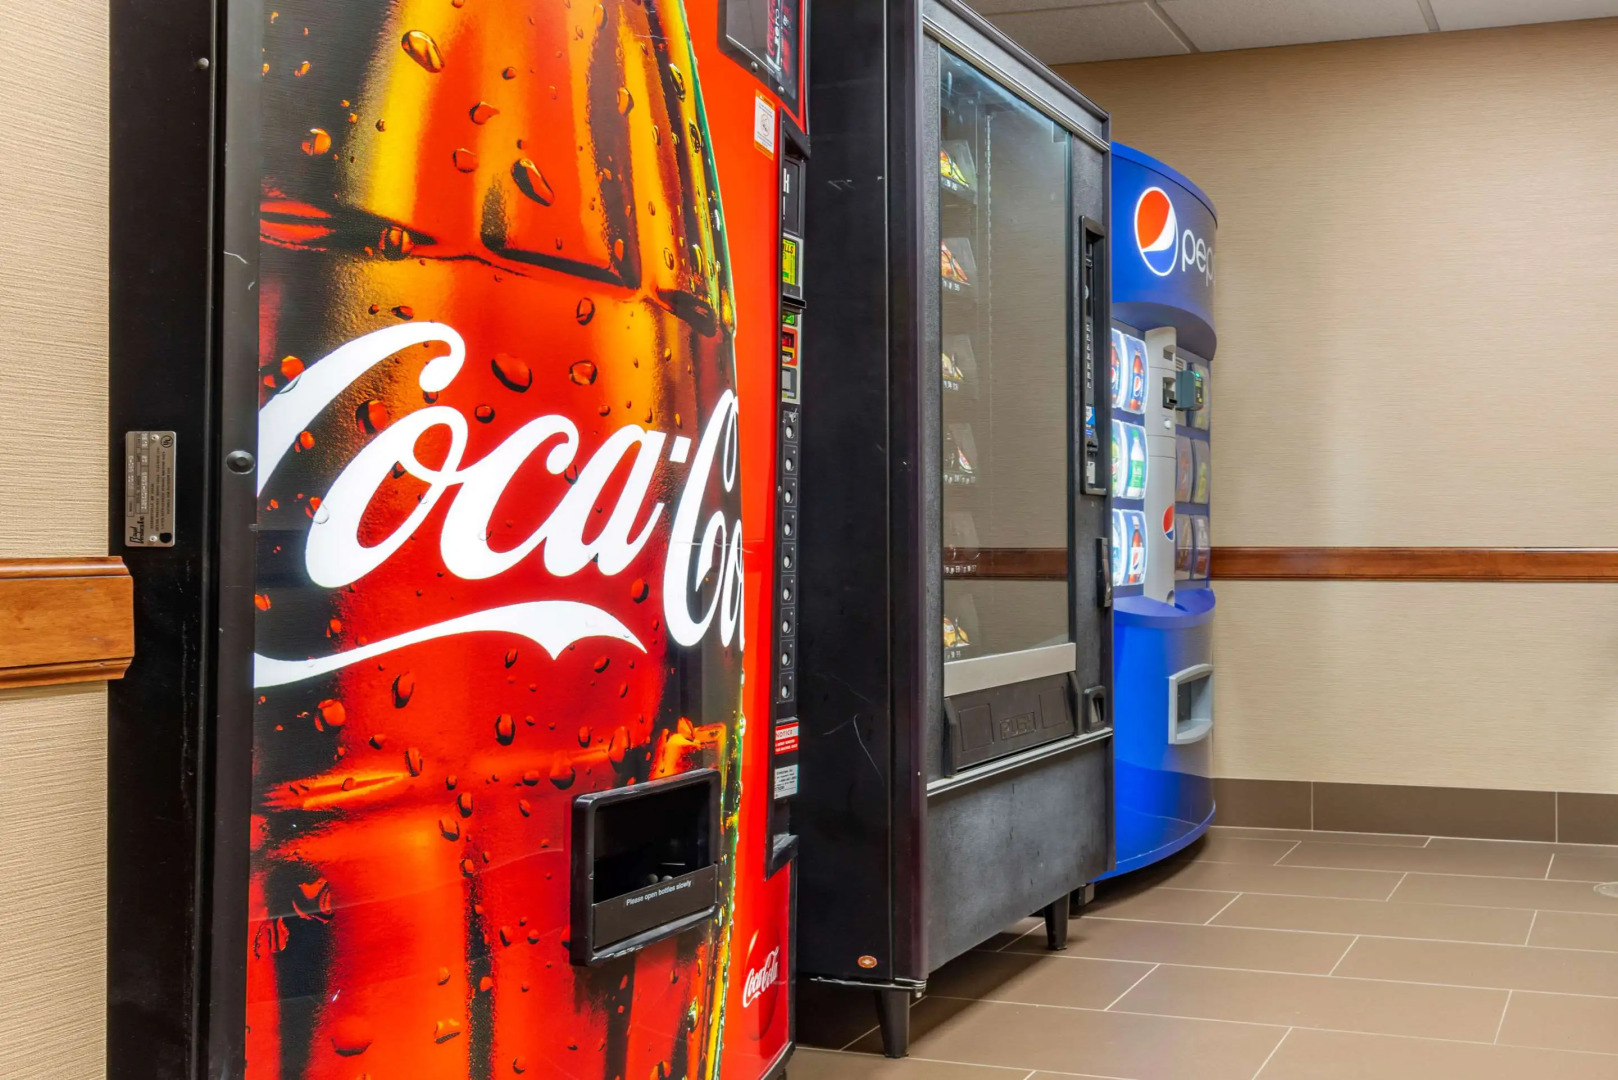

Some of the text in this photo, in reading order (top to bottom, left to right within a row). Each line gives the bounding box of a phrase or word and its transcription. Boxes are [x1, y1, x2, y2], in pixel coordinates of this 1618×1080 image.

[625, 880, 692, 906] Please open bottles slowly
